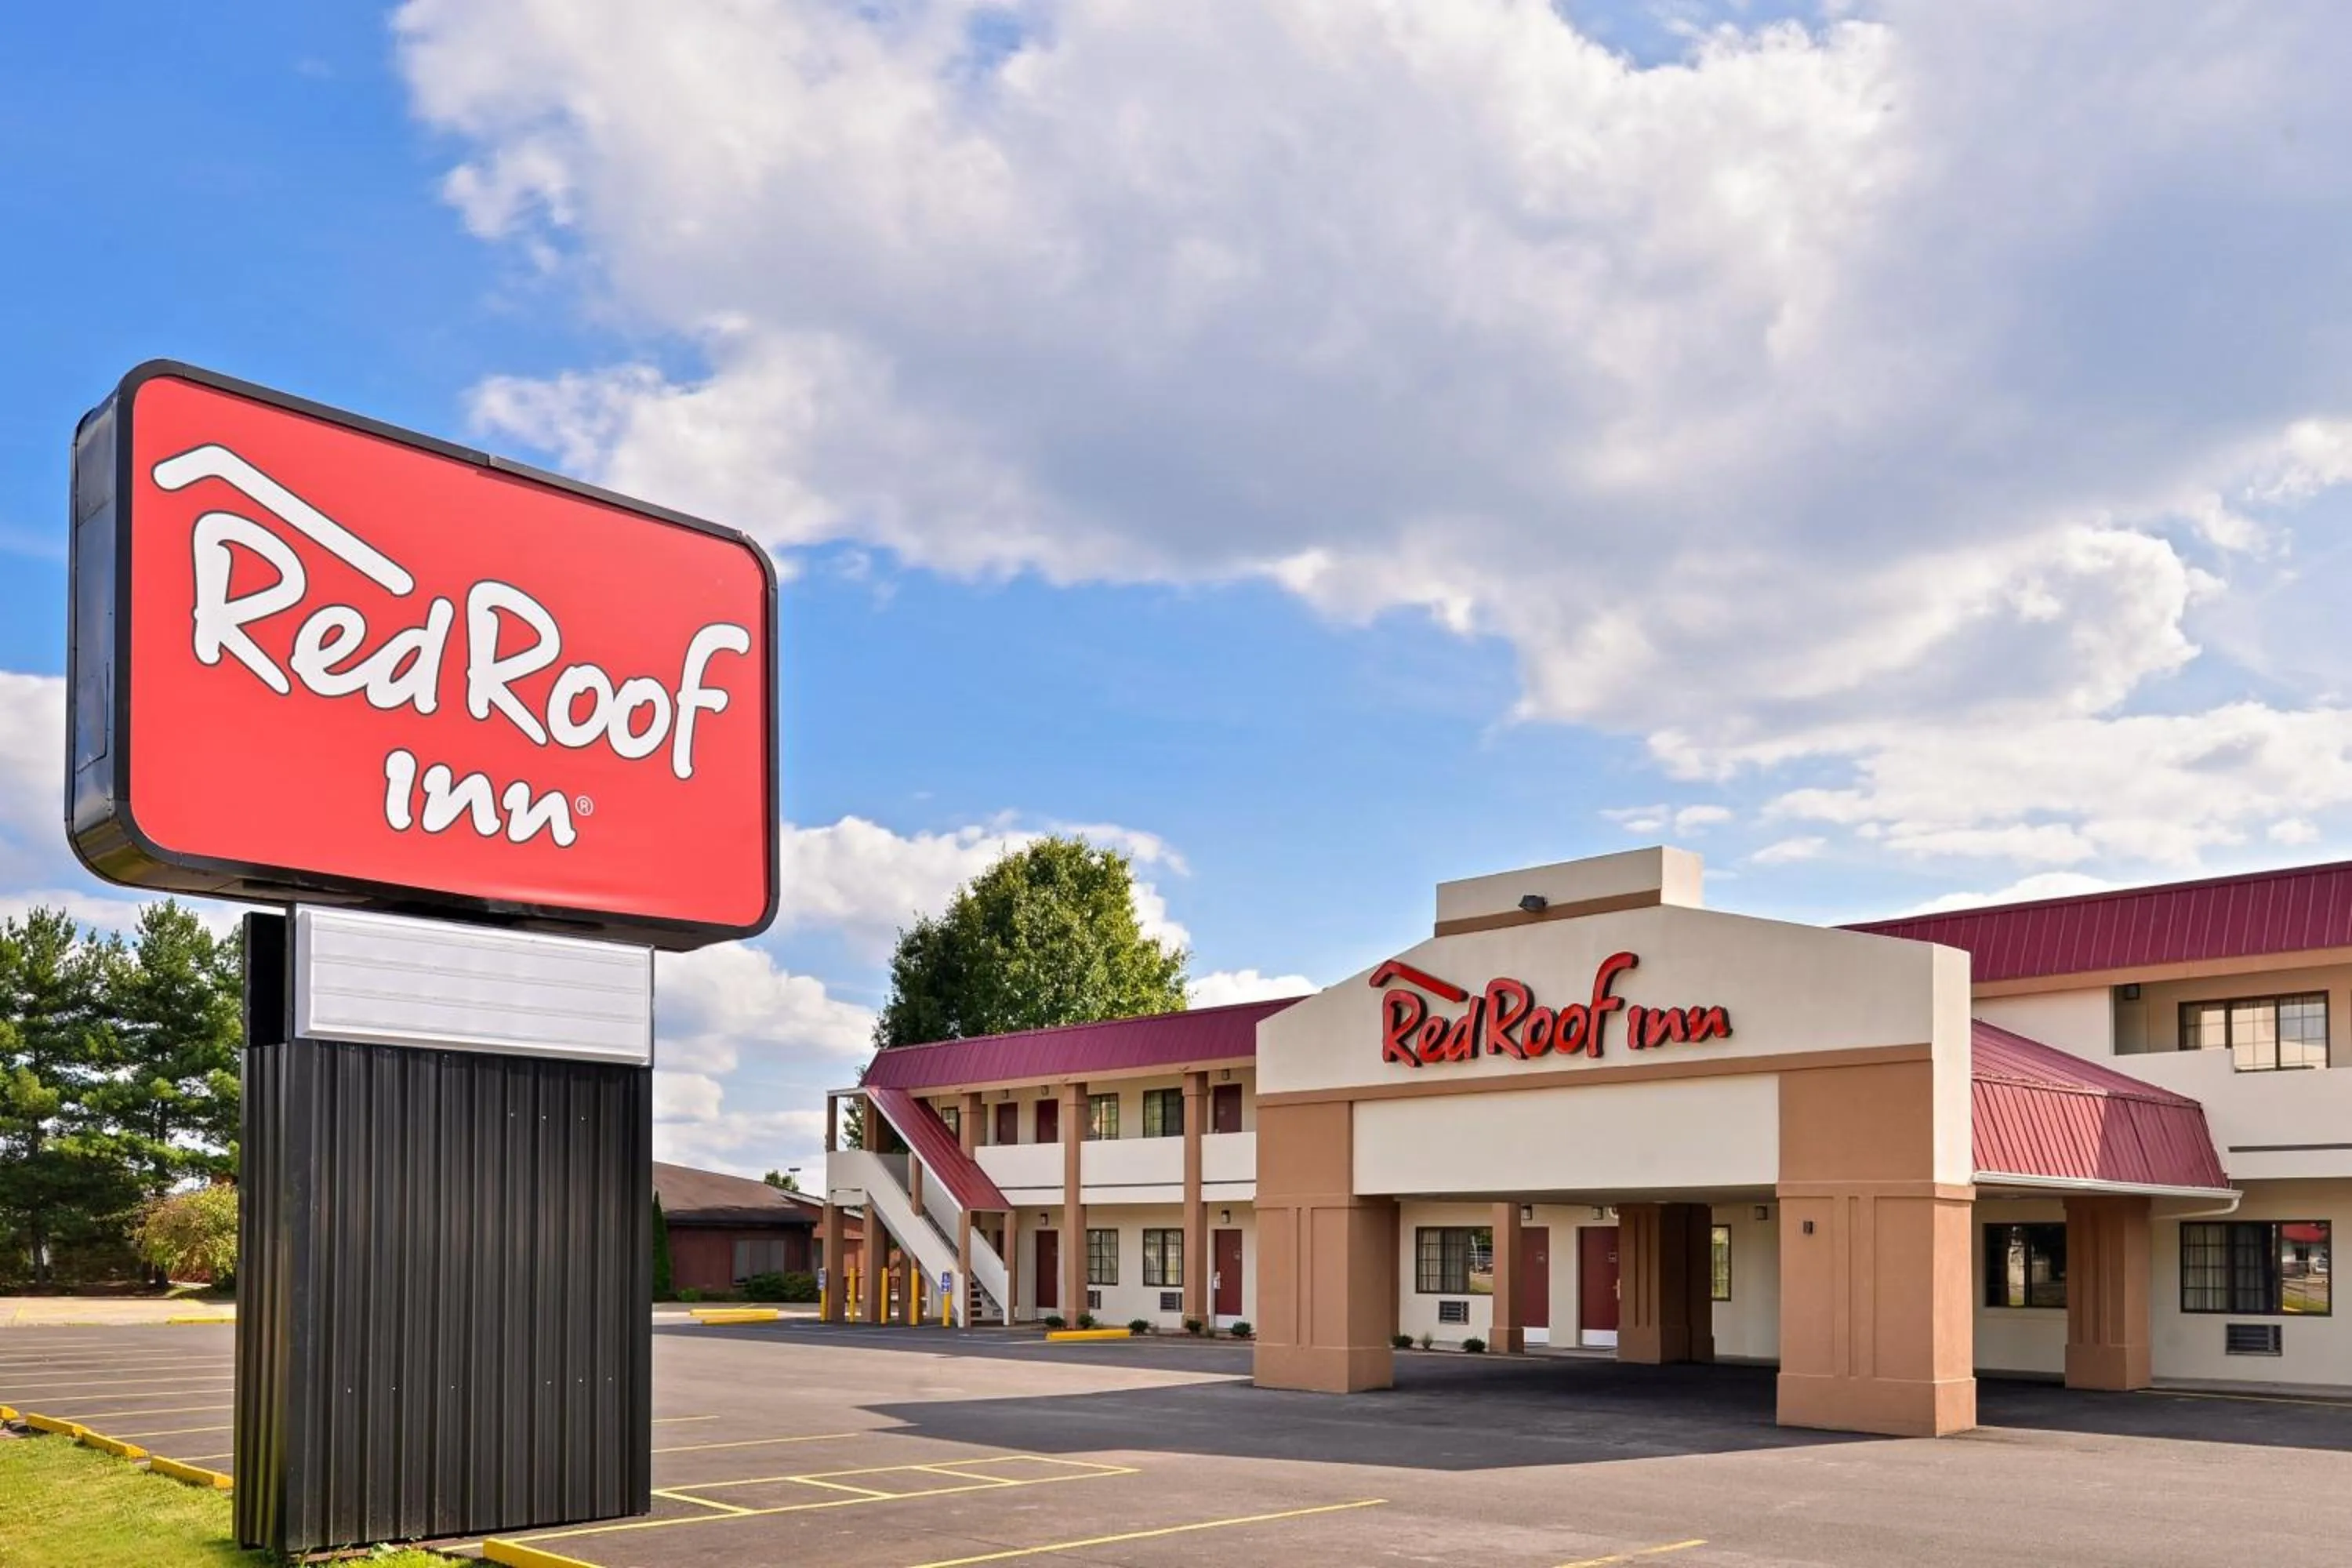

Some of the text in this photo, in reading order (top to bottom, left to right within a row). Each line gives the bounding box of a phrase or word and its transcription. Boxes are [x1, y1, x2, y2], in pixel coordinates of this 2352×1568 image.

[191, 510, 751, 780] Red Roof
[1382, 989, 1484, 1067] Red
[1485, 951, 1639, 1059] Roof
